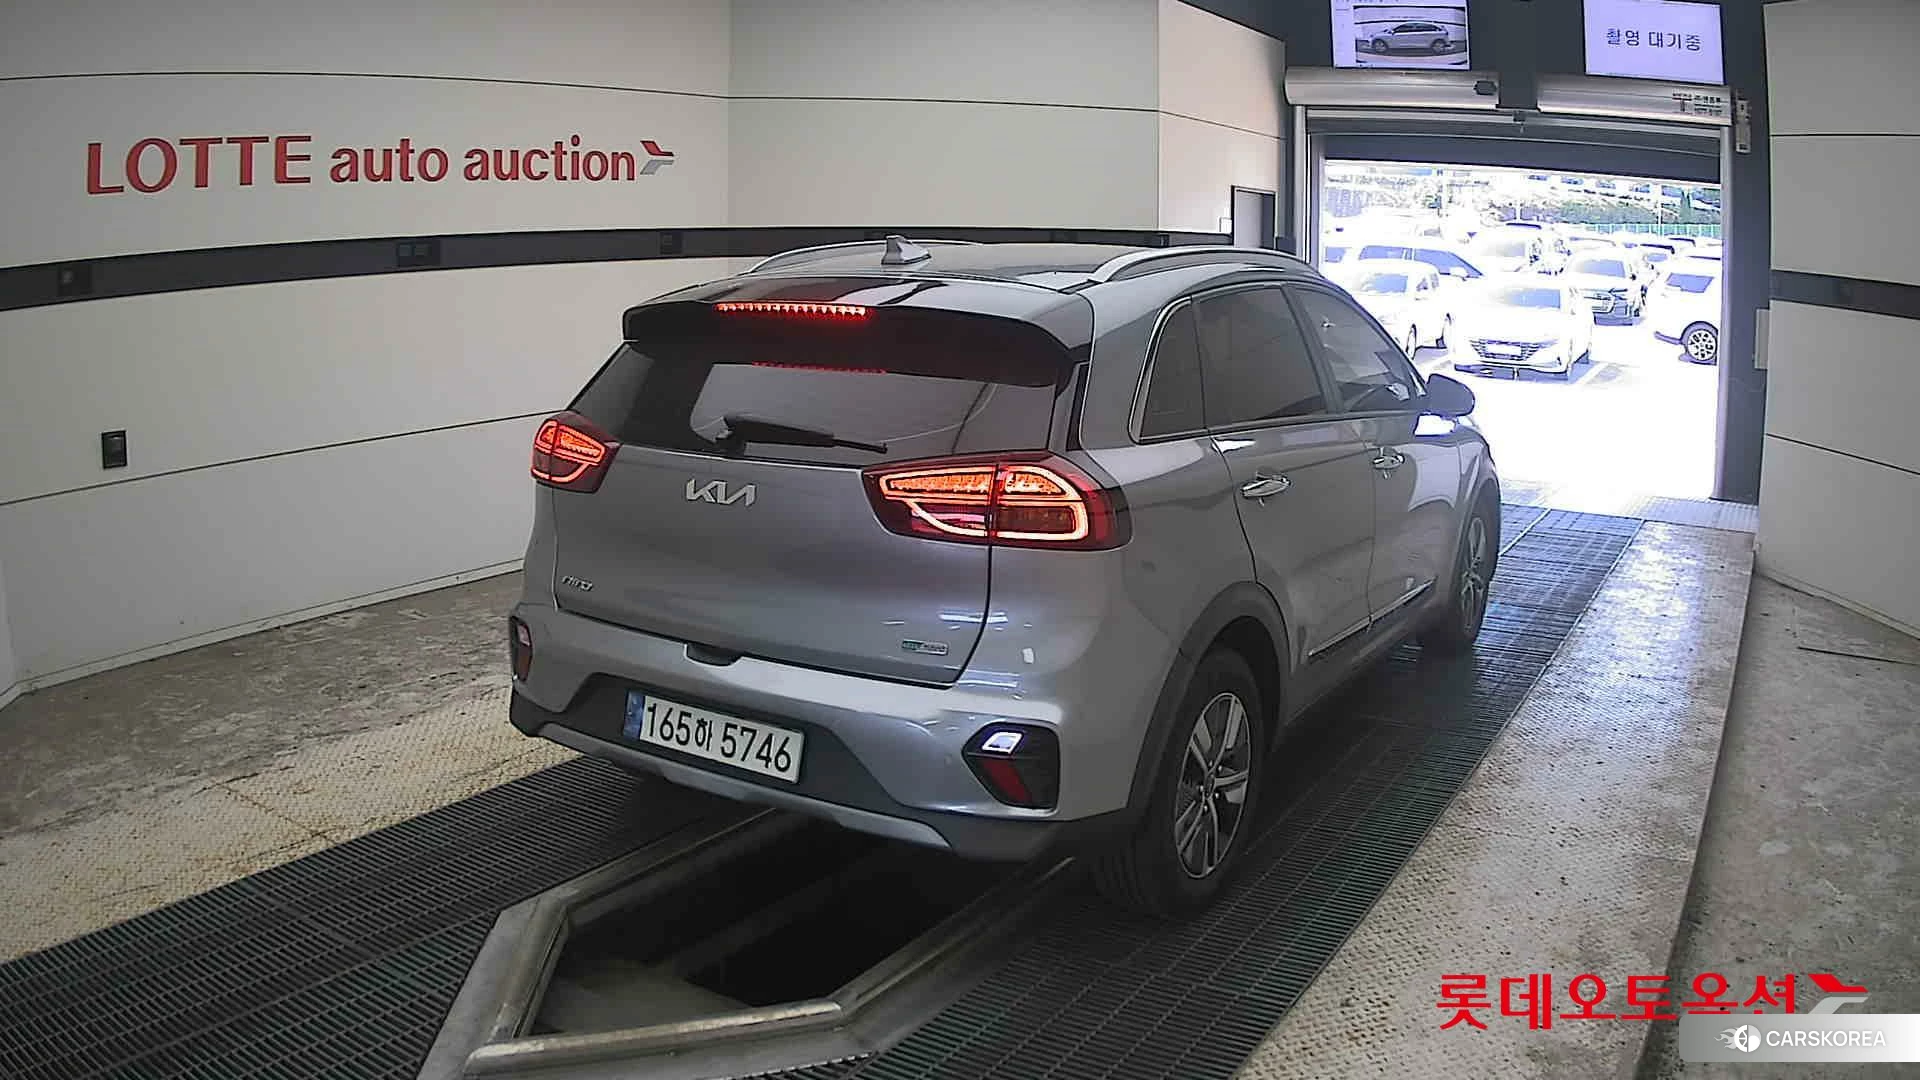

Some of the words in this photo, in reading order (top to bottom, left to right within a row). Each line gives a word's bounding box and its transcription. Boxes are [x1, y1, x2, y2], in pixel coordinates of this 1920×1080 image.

[1607, 28, 1640, 47] 촬영
[1648, 31, 1701, 52] 대기중
[87, 136, 312, 195] LOTTE
[329, 138, 449, 183] auto
[463, 135, 637, 182] auction
[648, 703, 713, 751] 165하
[720, 722, 791, 772] 5746
